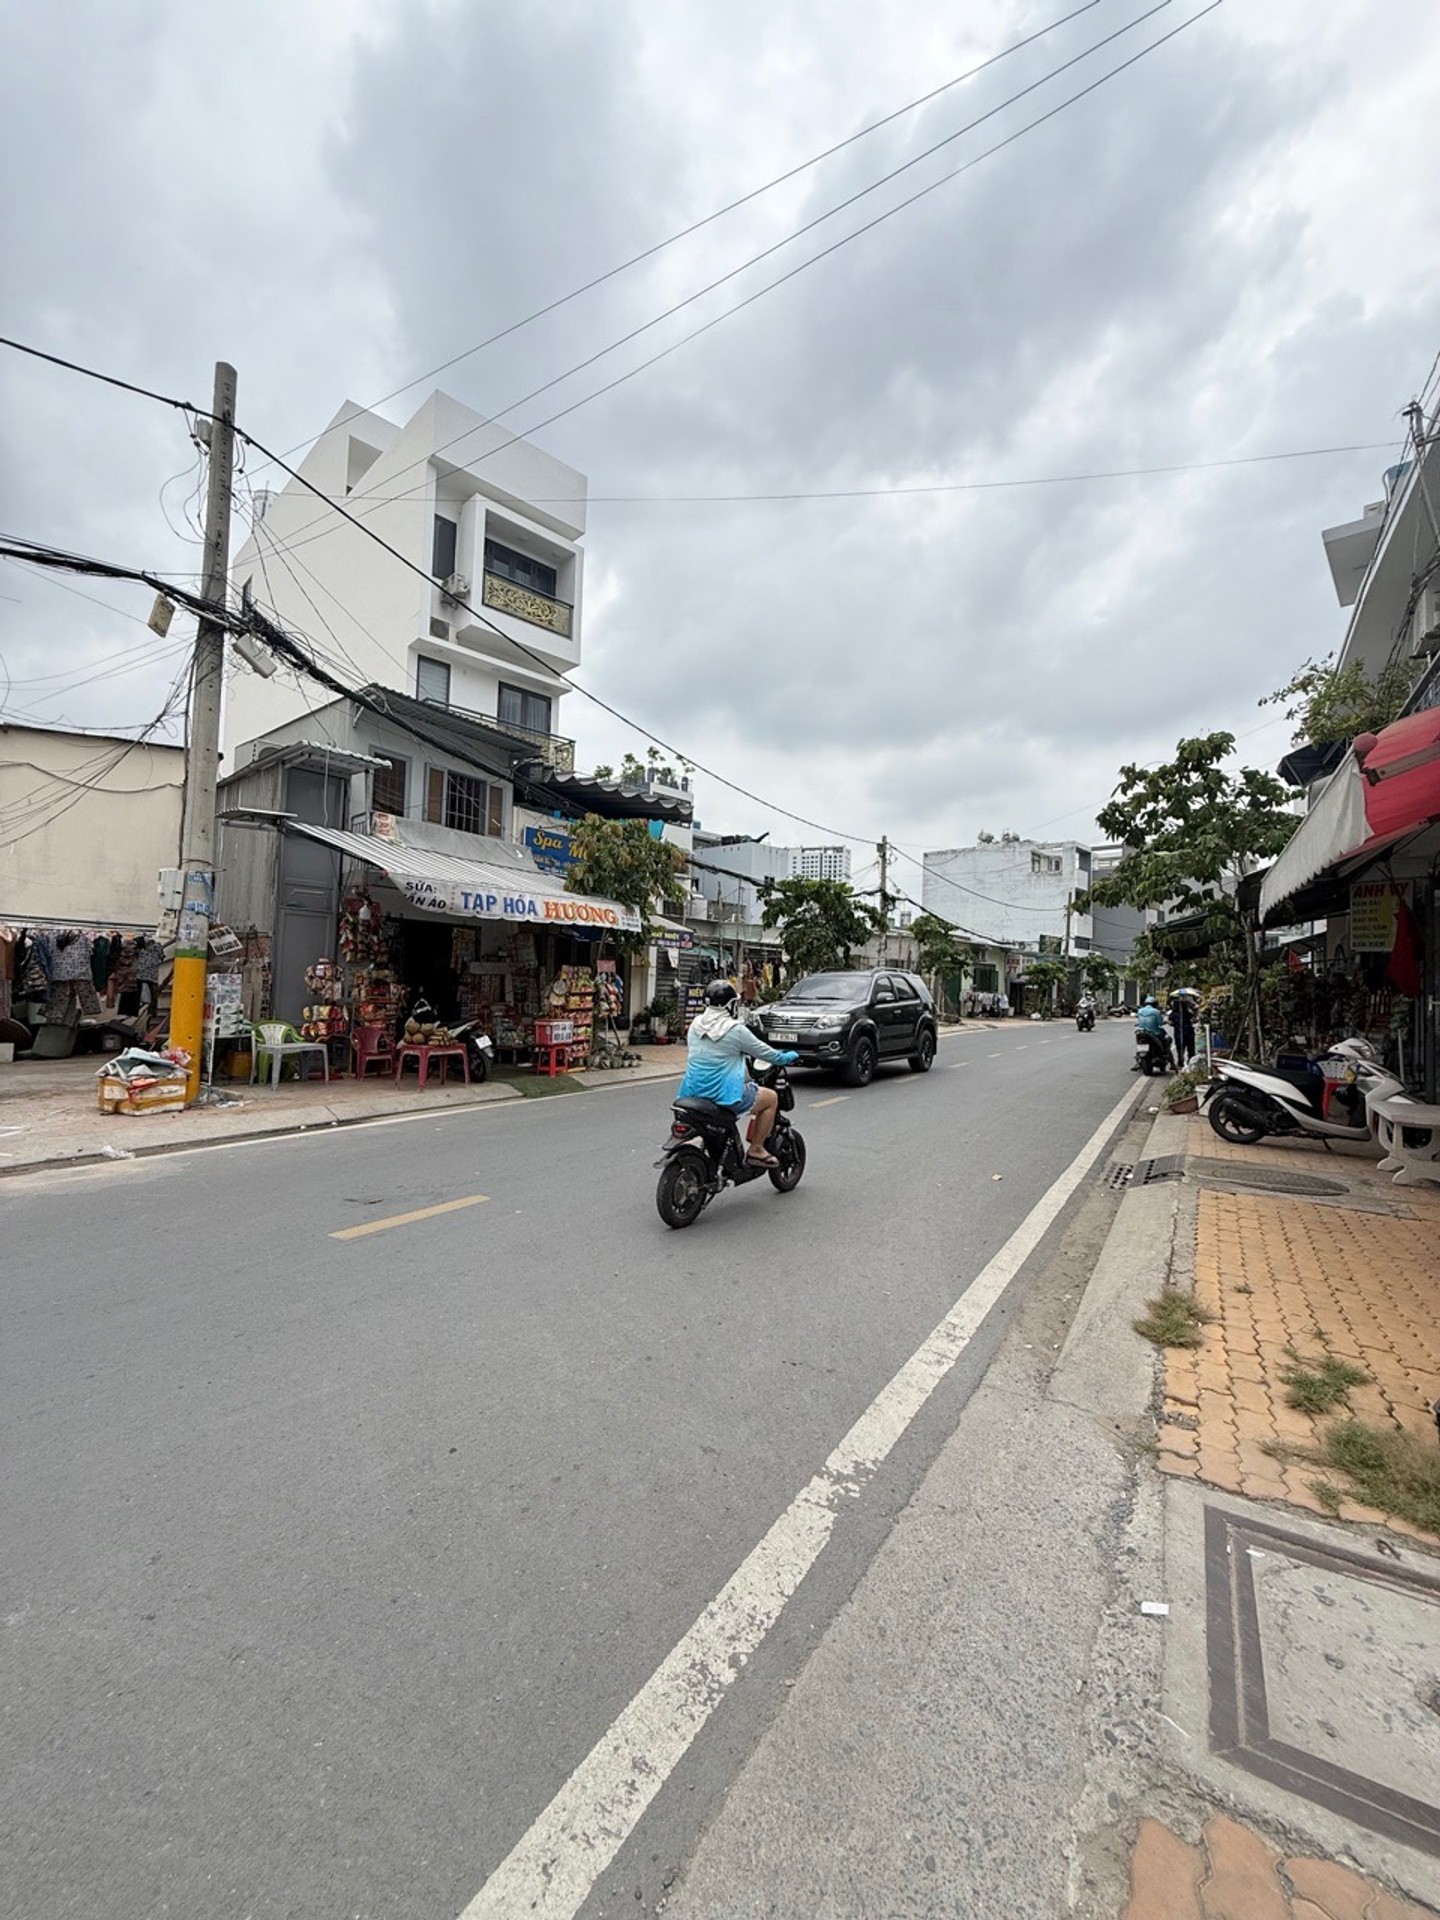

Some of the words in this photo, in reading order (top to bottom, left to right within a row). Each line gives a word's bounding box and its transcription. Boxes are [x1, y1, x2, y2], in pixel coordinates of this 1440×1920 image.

[533, 830, 563, 850] Spa
[1353, 885, 1386, 898] ANH
[427, 896, 447, 909] ÁO
[461, 891, 497, 914] TẠP
[503, 894, 537, 916] HÓA
[543, 901, 618, 926] HƯƠNG
